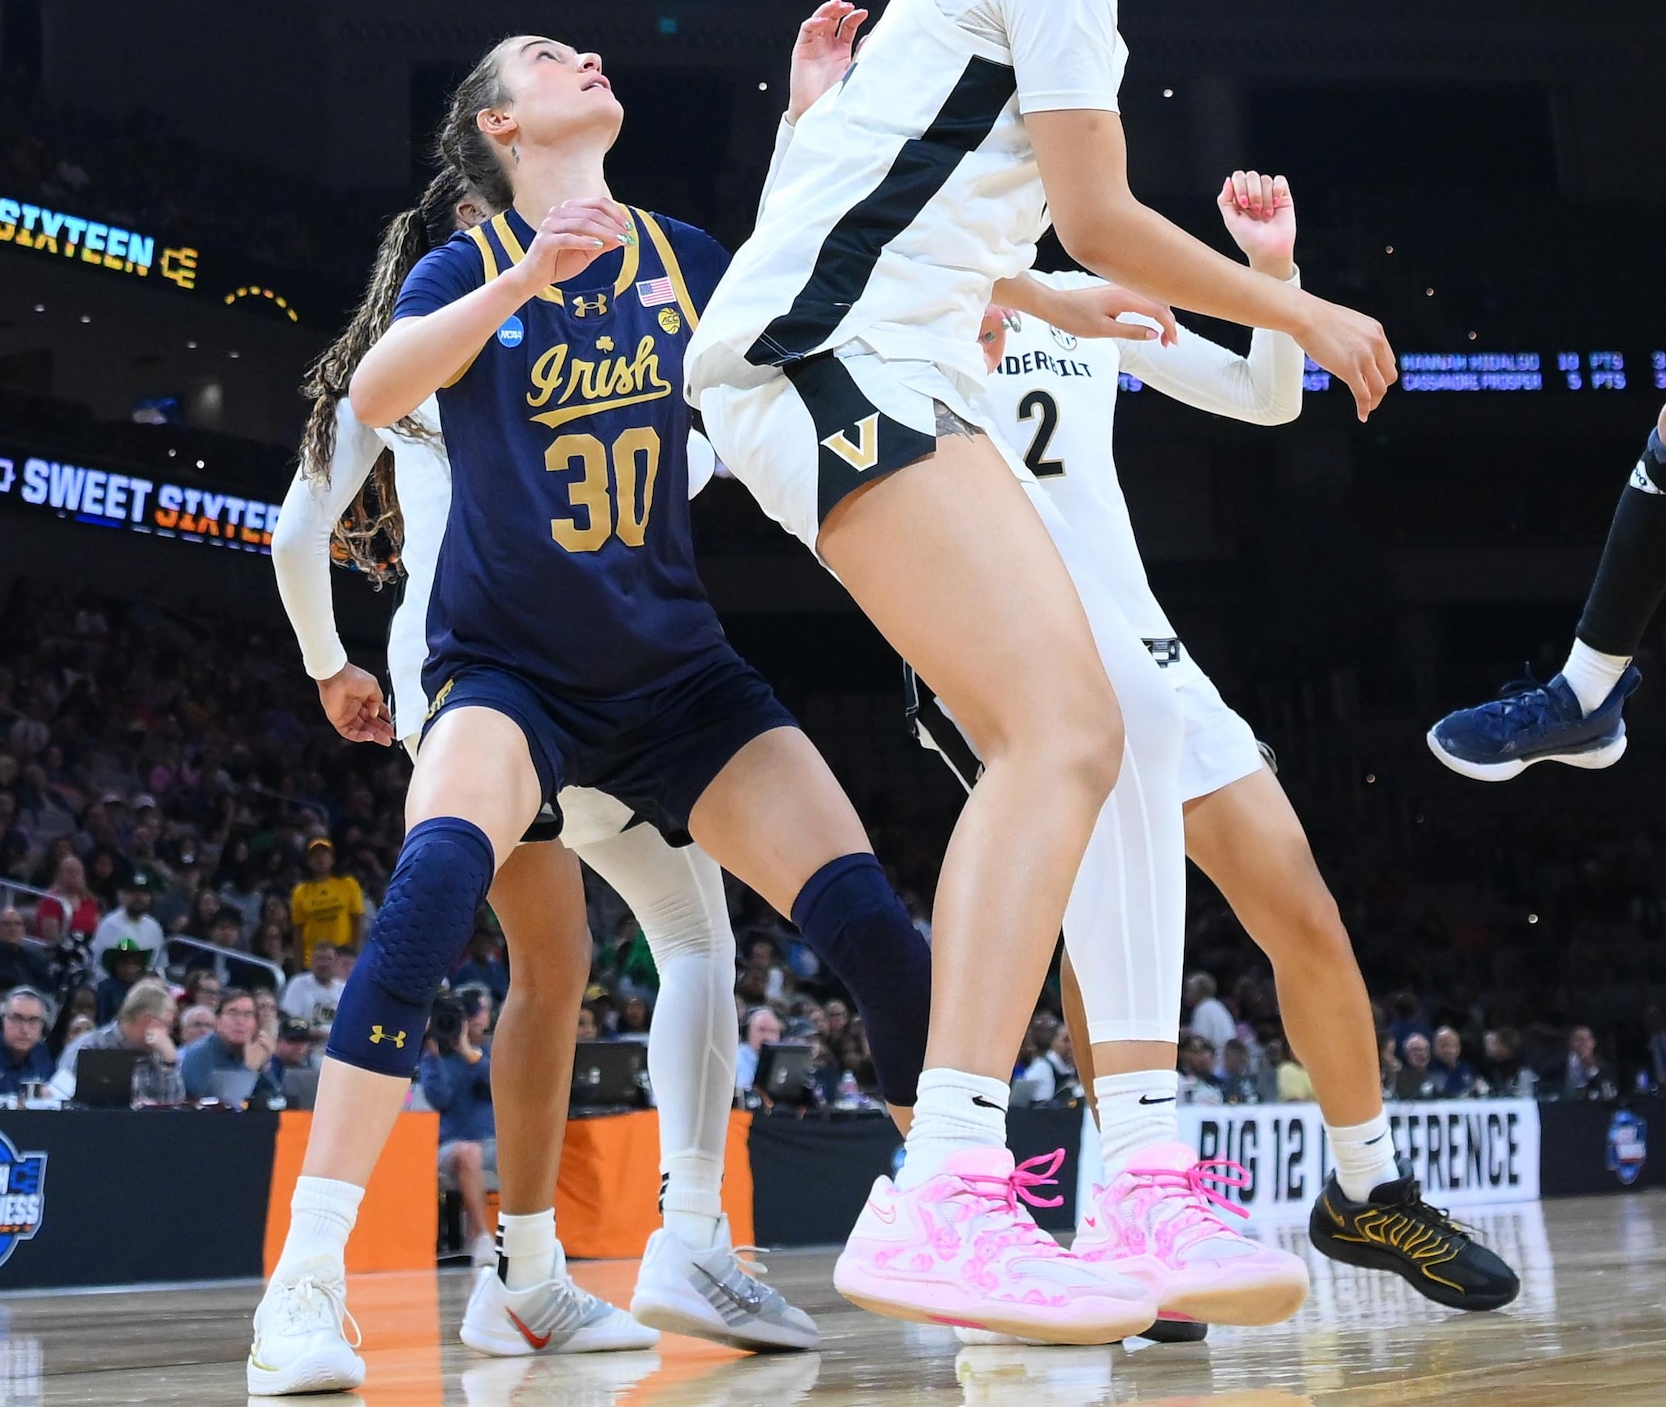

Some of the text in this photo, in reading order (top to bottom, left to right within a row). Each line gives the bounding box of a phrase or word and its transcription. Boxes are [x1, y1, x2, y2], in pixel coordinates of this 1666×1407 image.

[500, 330, 522, 341] NCAA
[661, 314, 680, 325] ACC
[526, 335, 672, 409] Irish
[819, 411, 881, 473] V
[1016, 388, 1067, 480] 2
[21, 457, 281, 546] SWEET SIXTEE
[544, 426, 661, 553] 30
[1200, 1119, 1257, 1204] BIG
[1272, 1117, 1306, 1202] 12
